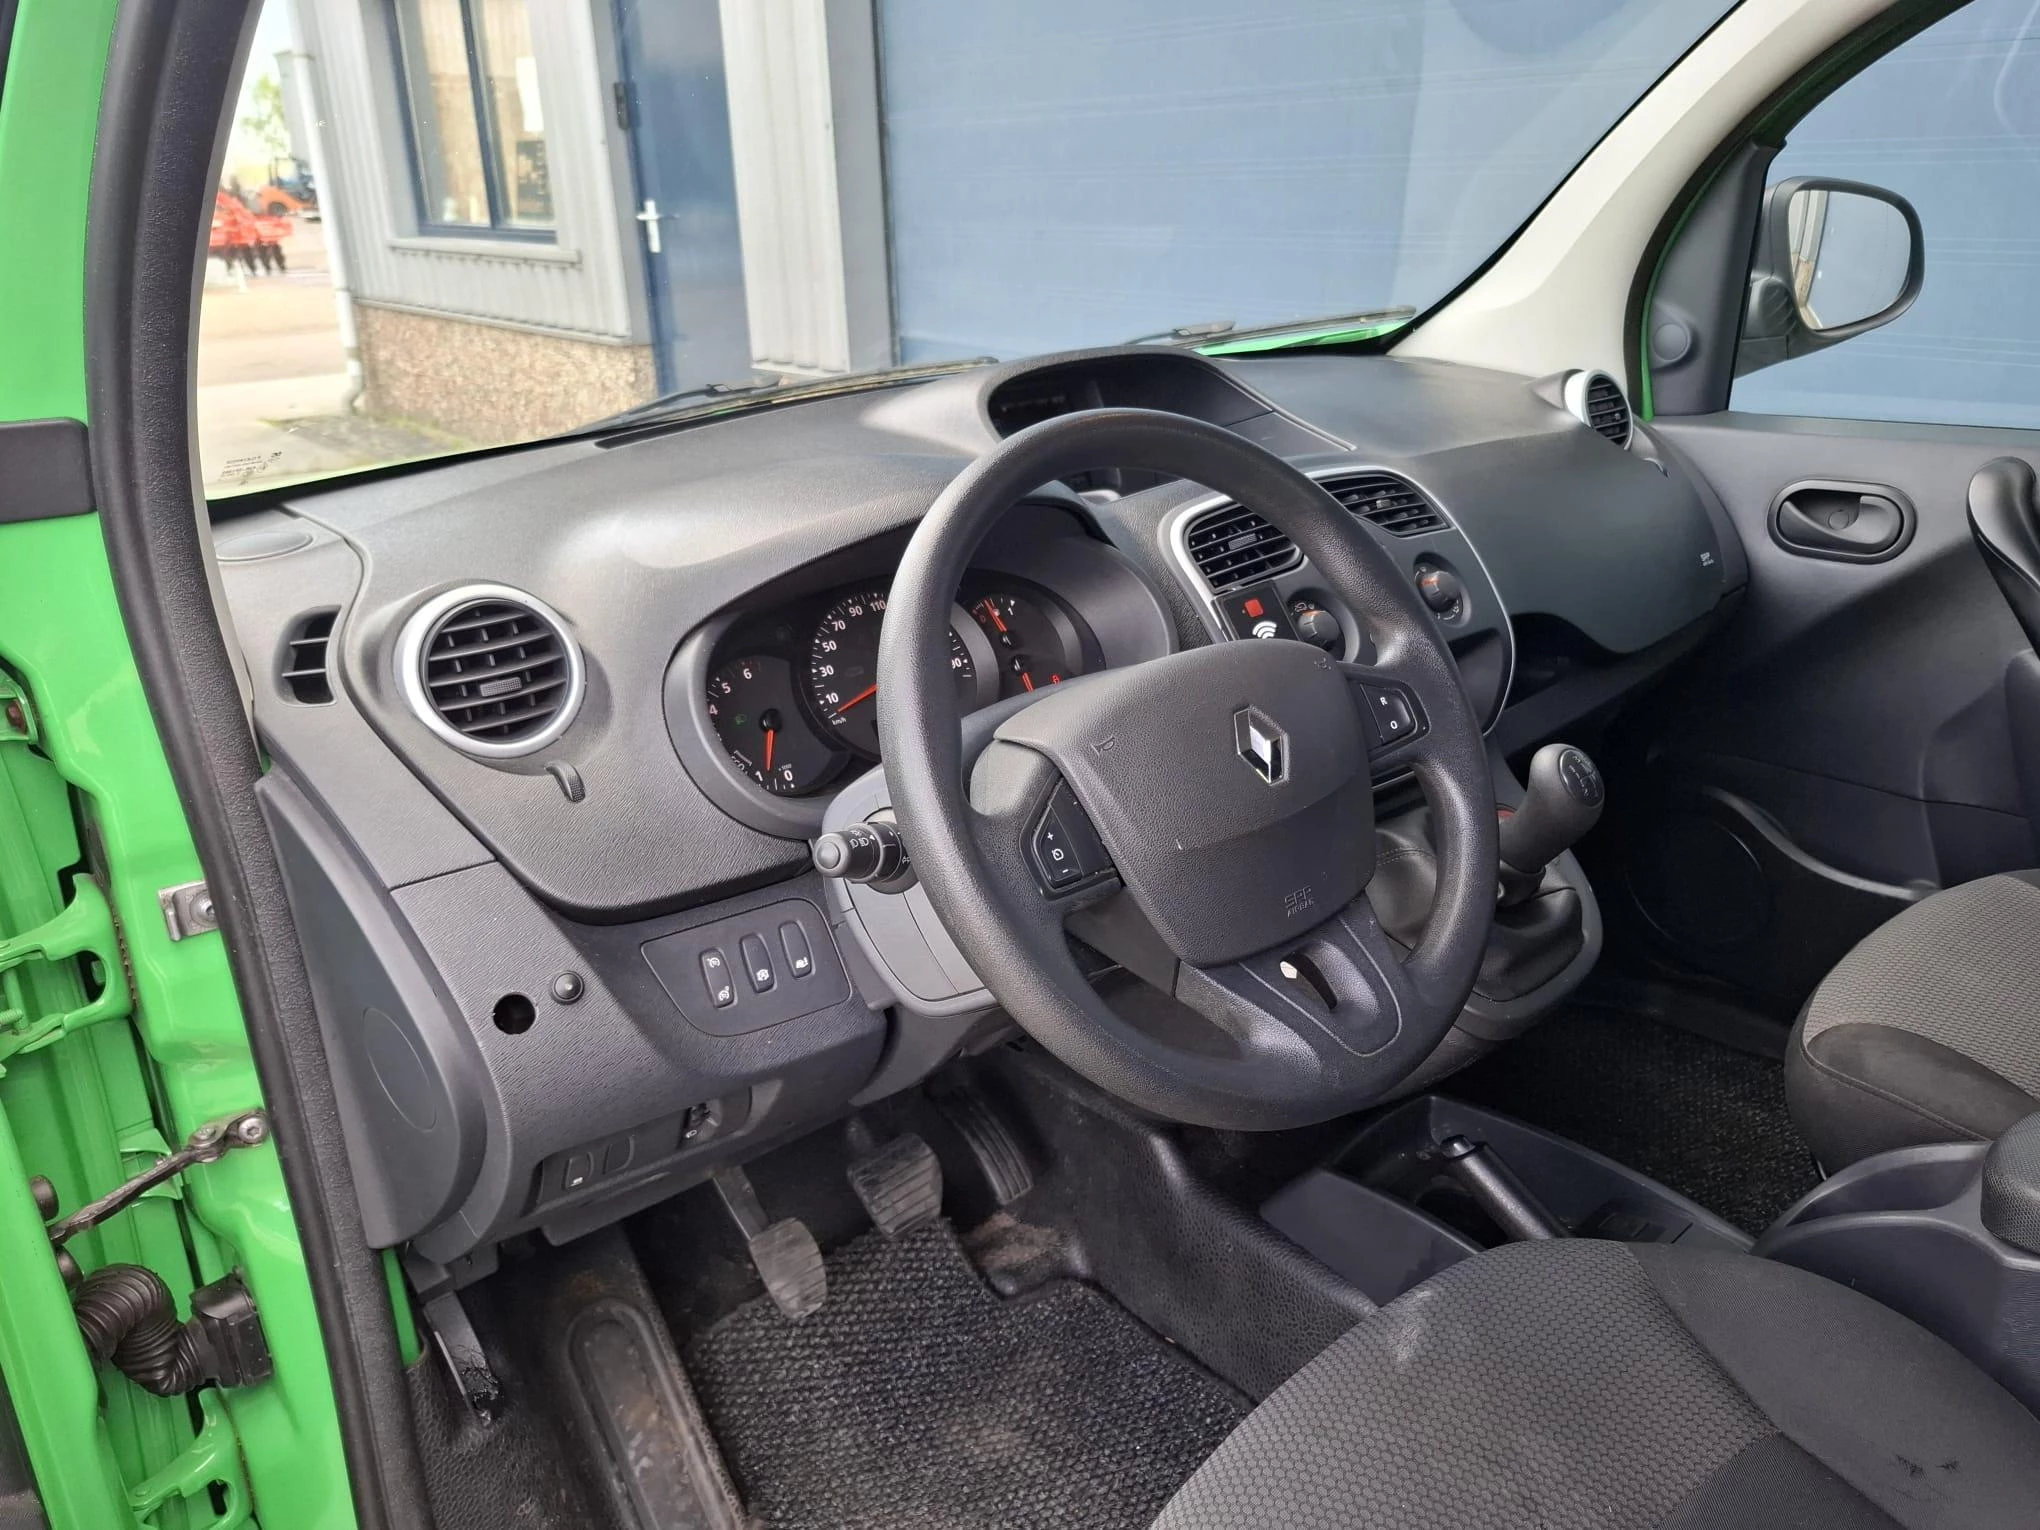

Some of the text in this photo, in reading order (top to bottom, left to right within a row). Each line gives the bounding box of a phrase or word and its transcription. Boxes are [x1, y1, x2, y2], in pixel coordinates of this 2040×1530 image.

[849, 605, 862, 617] 90
[870, 600, 887, 612] 110
[832, 620, 846, 632] 70
[822, 640, 837, 652] 50
[743, 668, 752, 680] 6
[820, 665, 834, 677] 30
[722, 682, 731, 694] 5
[826, 692, 839, 704] 10
[1380, 696, 1388, 706] R
[709, 704, 718, 716] 4
[755, 771, 763, 782] 1
[784, 769, 793, 782] 0
